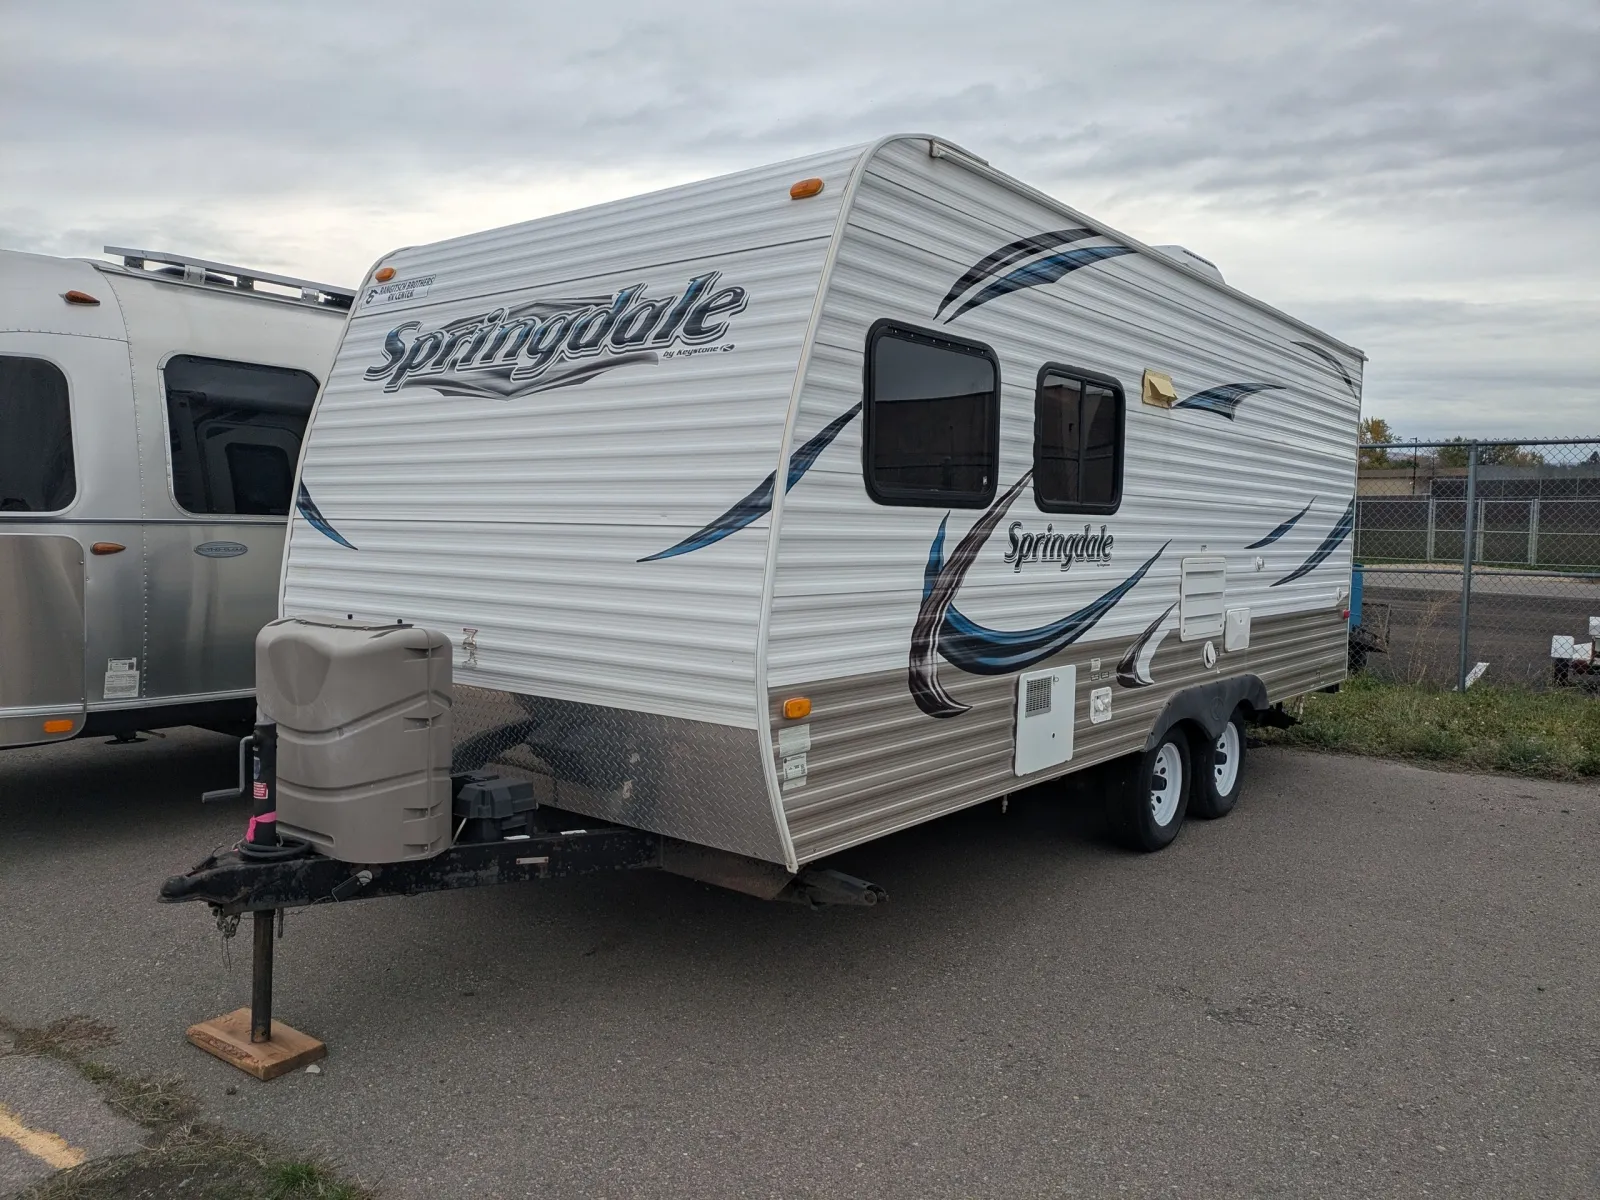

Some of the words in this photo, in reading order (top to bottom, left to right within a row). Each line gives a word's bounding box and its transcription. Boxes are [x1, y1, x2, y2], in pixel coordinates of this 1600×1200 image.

[406, 277, 434, 290] BROTHERS
[395, 290, 414, 300] CENTER
[363, 270, 750, 393] Springdale
[663, 350, 675, 358] by
[676, 346, 719, 357] Keystone
[1004, 521, 1114, 573] Springdale
